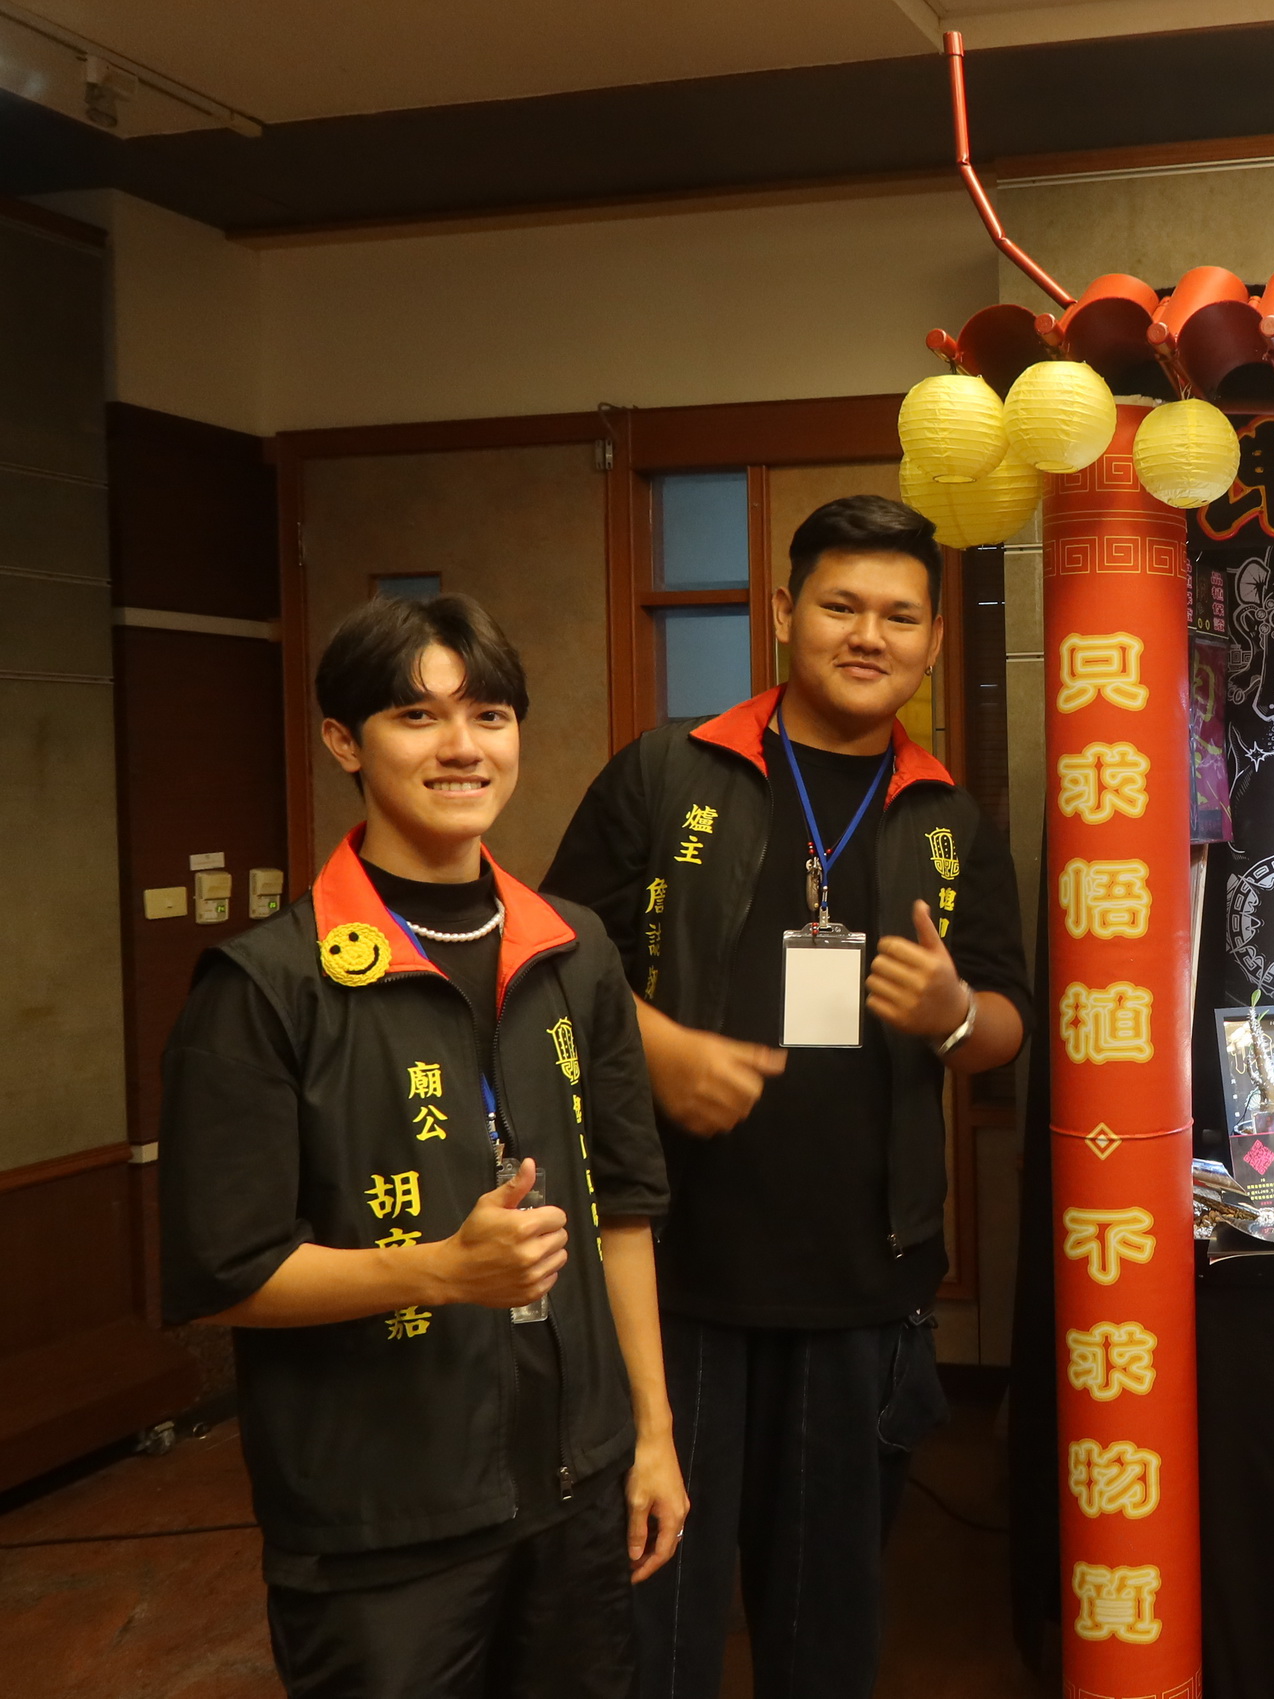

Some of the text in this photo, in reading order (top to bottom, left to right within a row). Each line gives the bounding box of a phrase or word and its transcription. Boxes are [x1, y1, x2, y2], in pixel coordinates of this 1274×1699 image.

[674, 804, 718, 864] 爐主
[407, 1061, 448, 1141] 廟公
[1063, 1207, 1162, 1644] 不求物質
